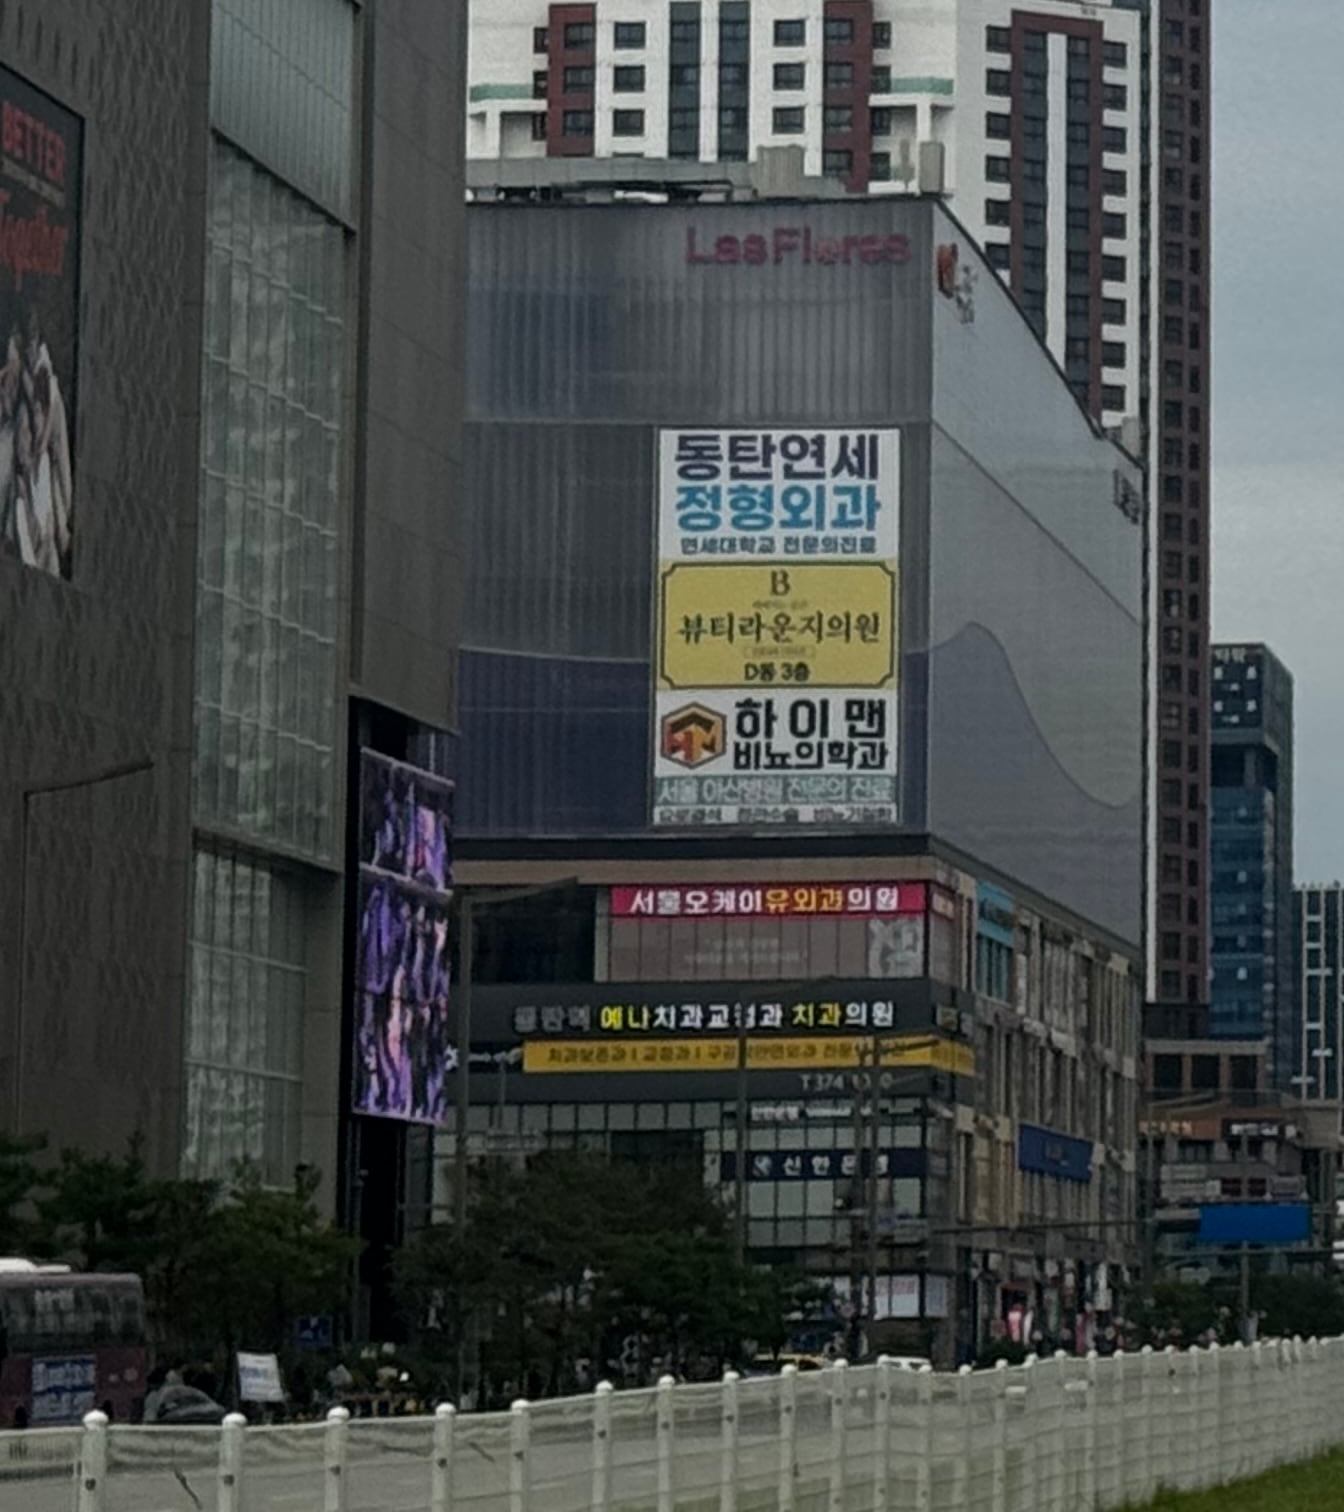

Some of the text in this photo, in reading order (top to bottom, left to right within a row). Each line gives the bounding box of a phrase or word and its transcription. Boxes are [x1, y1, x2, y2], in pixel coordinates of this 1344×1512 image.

[675, 434, 879, 481] 동탄연세
[675, 484, 881, 532] 정형외과
[681, 535, 776, 555] 연세대학교
[770, 570, 790, 596] B
[677, 610, 881, 644] 뷰티라운지의원
[733, 741, 888, 771] 비뇨의학과
[657, 778, 698, 803] 서울
